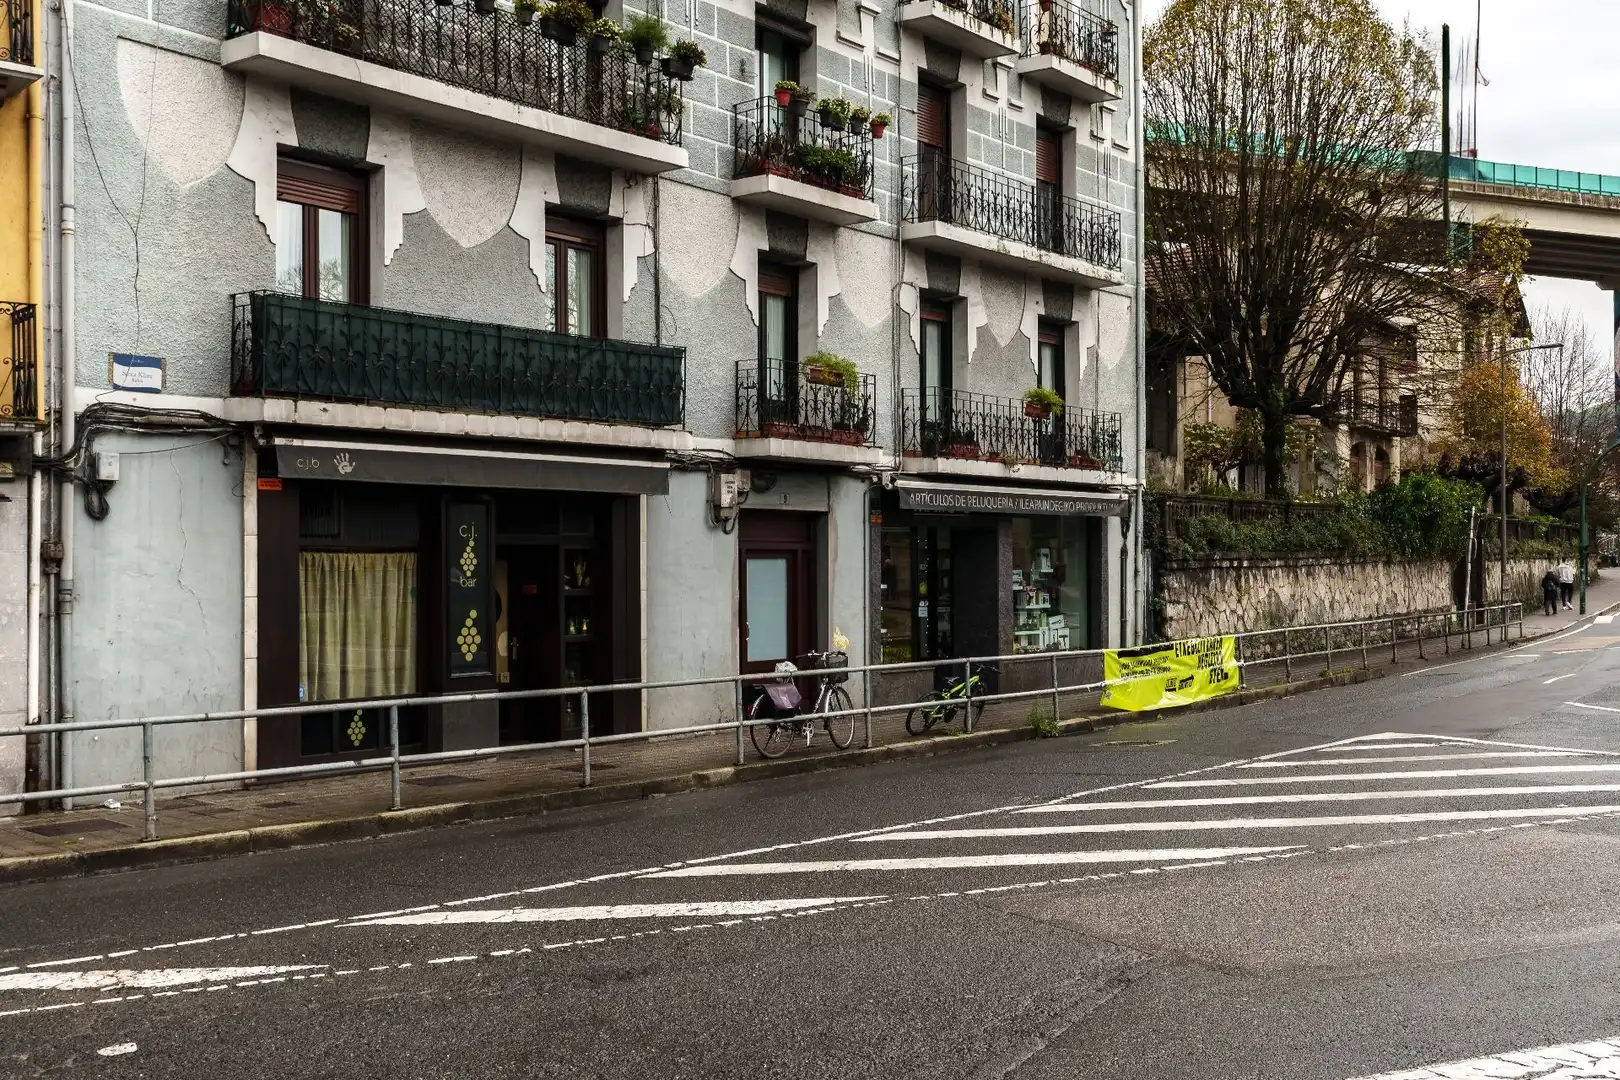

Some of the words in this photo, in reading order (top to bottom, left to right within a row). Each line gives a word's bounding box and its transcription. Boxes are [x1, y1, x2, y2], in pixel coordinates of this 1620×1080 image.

[909, 491, 954, 507] ARTÍCULOS
[955, 494, 966, 507] DE
[967, 494, 1013, 510] PELUQUERÍA
[459, 575, 477, 588] bar
